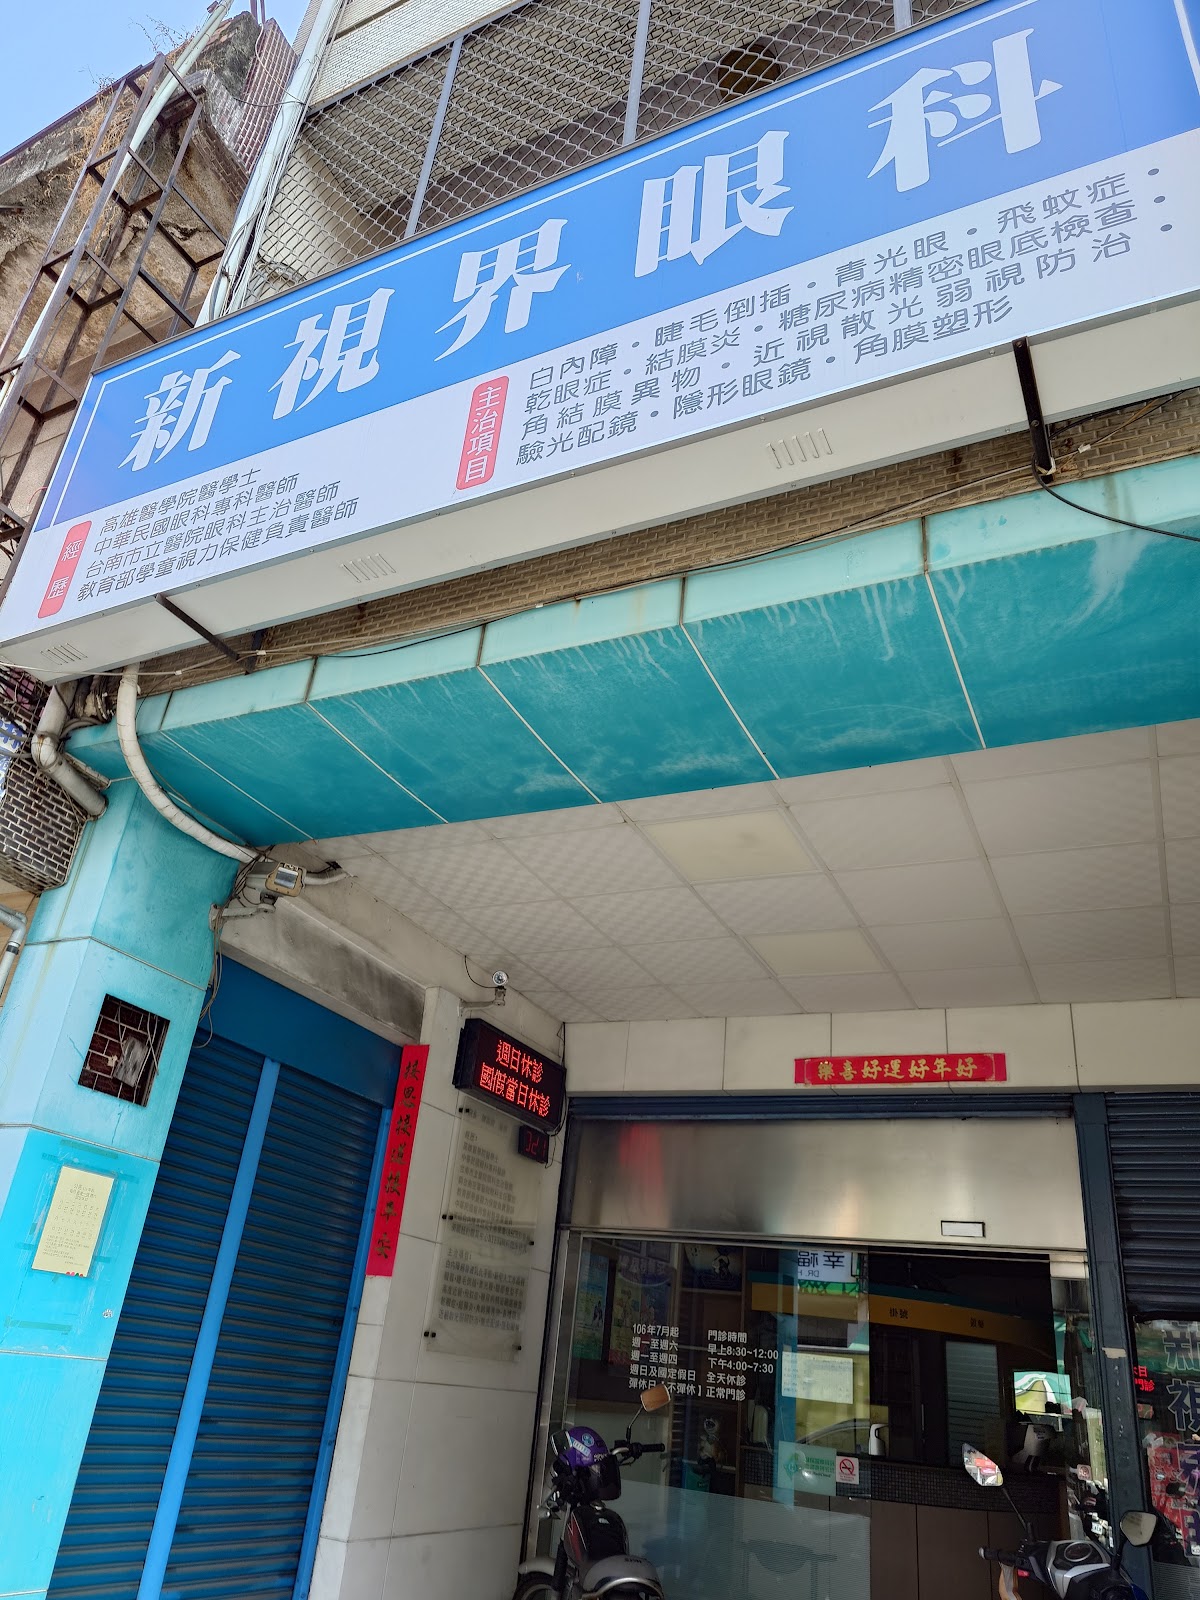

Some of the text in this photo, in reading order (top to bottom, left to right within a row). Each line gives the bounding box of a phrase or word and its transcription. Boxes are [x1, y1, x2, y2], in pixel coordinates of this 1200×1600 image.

[118, 28, 1062, 472] 新視界眼科
[465, 386, 502, 483] 主治項目
[100, 468, 261, 536] 高雄醫學院醫學士
[94, 473, 300, 555] 中華民國眼科專科醫師
[86, 481, 341, 579] 台南市立醫院眼科主治醫師
[77, 497, 360, 601] 教育部學童視力保健負責醫師
[47, 539, 82, 599] 經歷
[496, 1040, 544, 1083] 週日休診
[480, 1062, 550, 1117] 國假當日休診
[632, 1323, 680, 1338] 106年7月起
[707, 1329, 748, 1344] 門診時間
[631, 1336, 679, 1352] 週一至週六
[707, 1343, 779, 1360] 早上8:30~12:00
[630, 1350, 678, 1366] 週一至週四
[707, 1357, 774, 1374] 下午4:00~7:30
[629, 1364, 697, 1382] 週日及國定假日
[706, 1371, 747, 1388] 全天休診
[628, 1377, 702, 1397] 彈休日不彈休】
[705, 1385, 747, 1402] 正常門診
